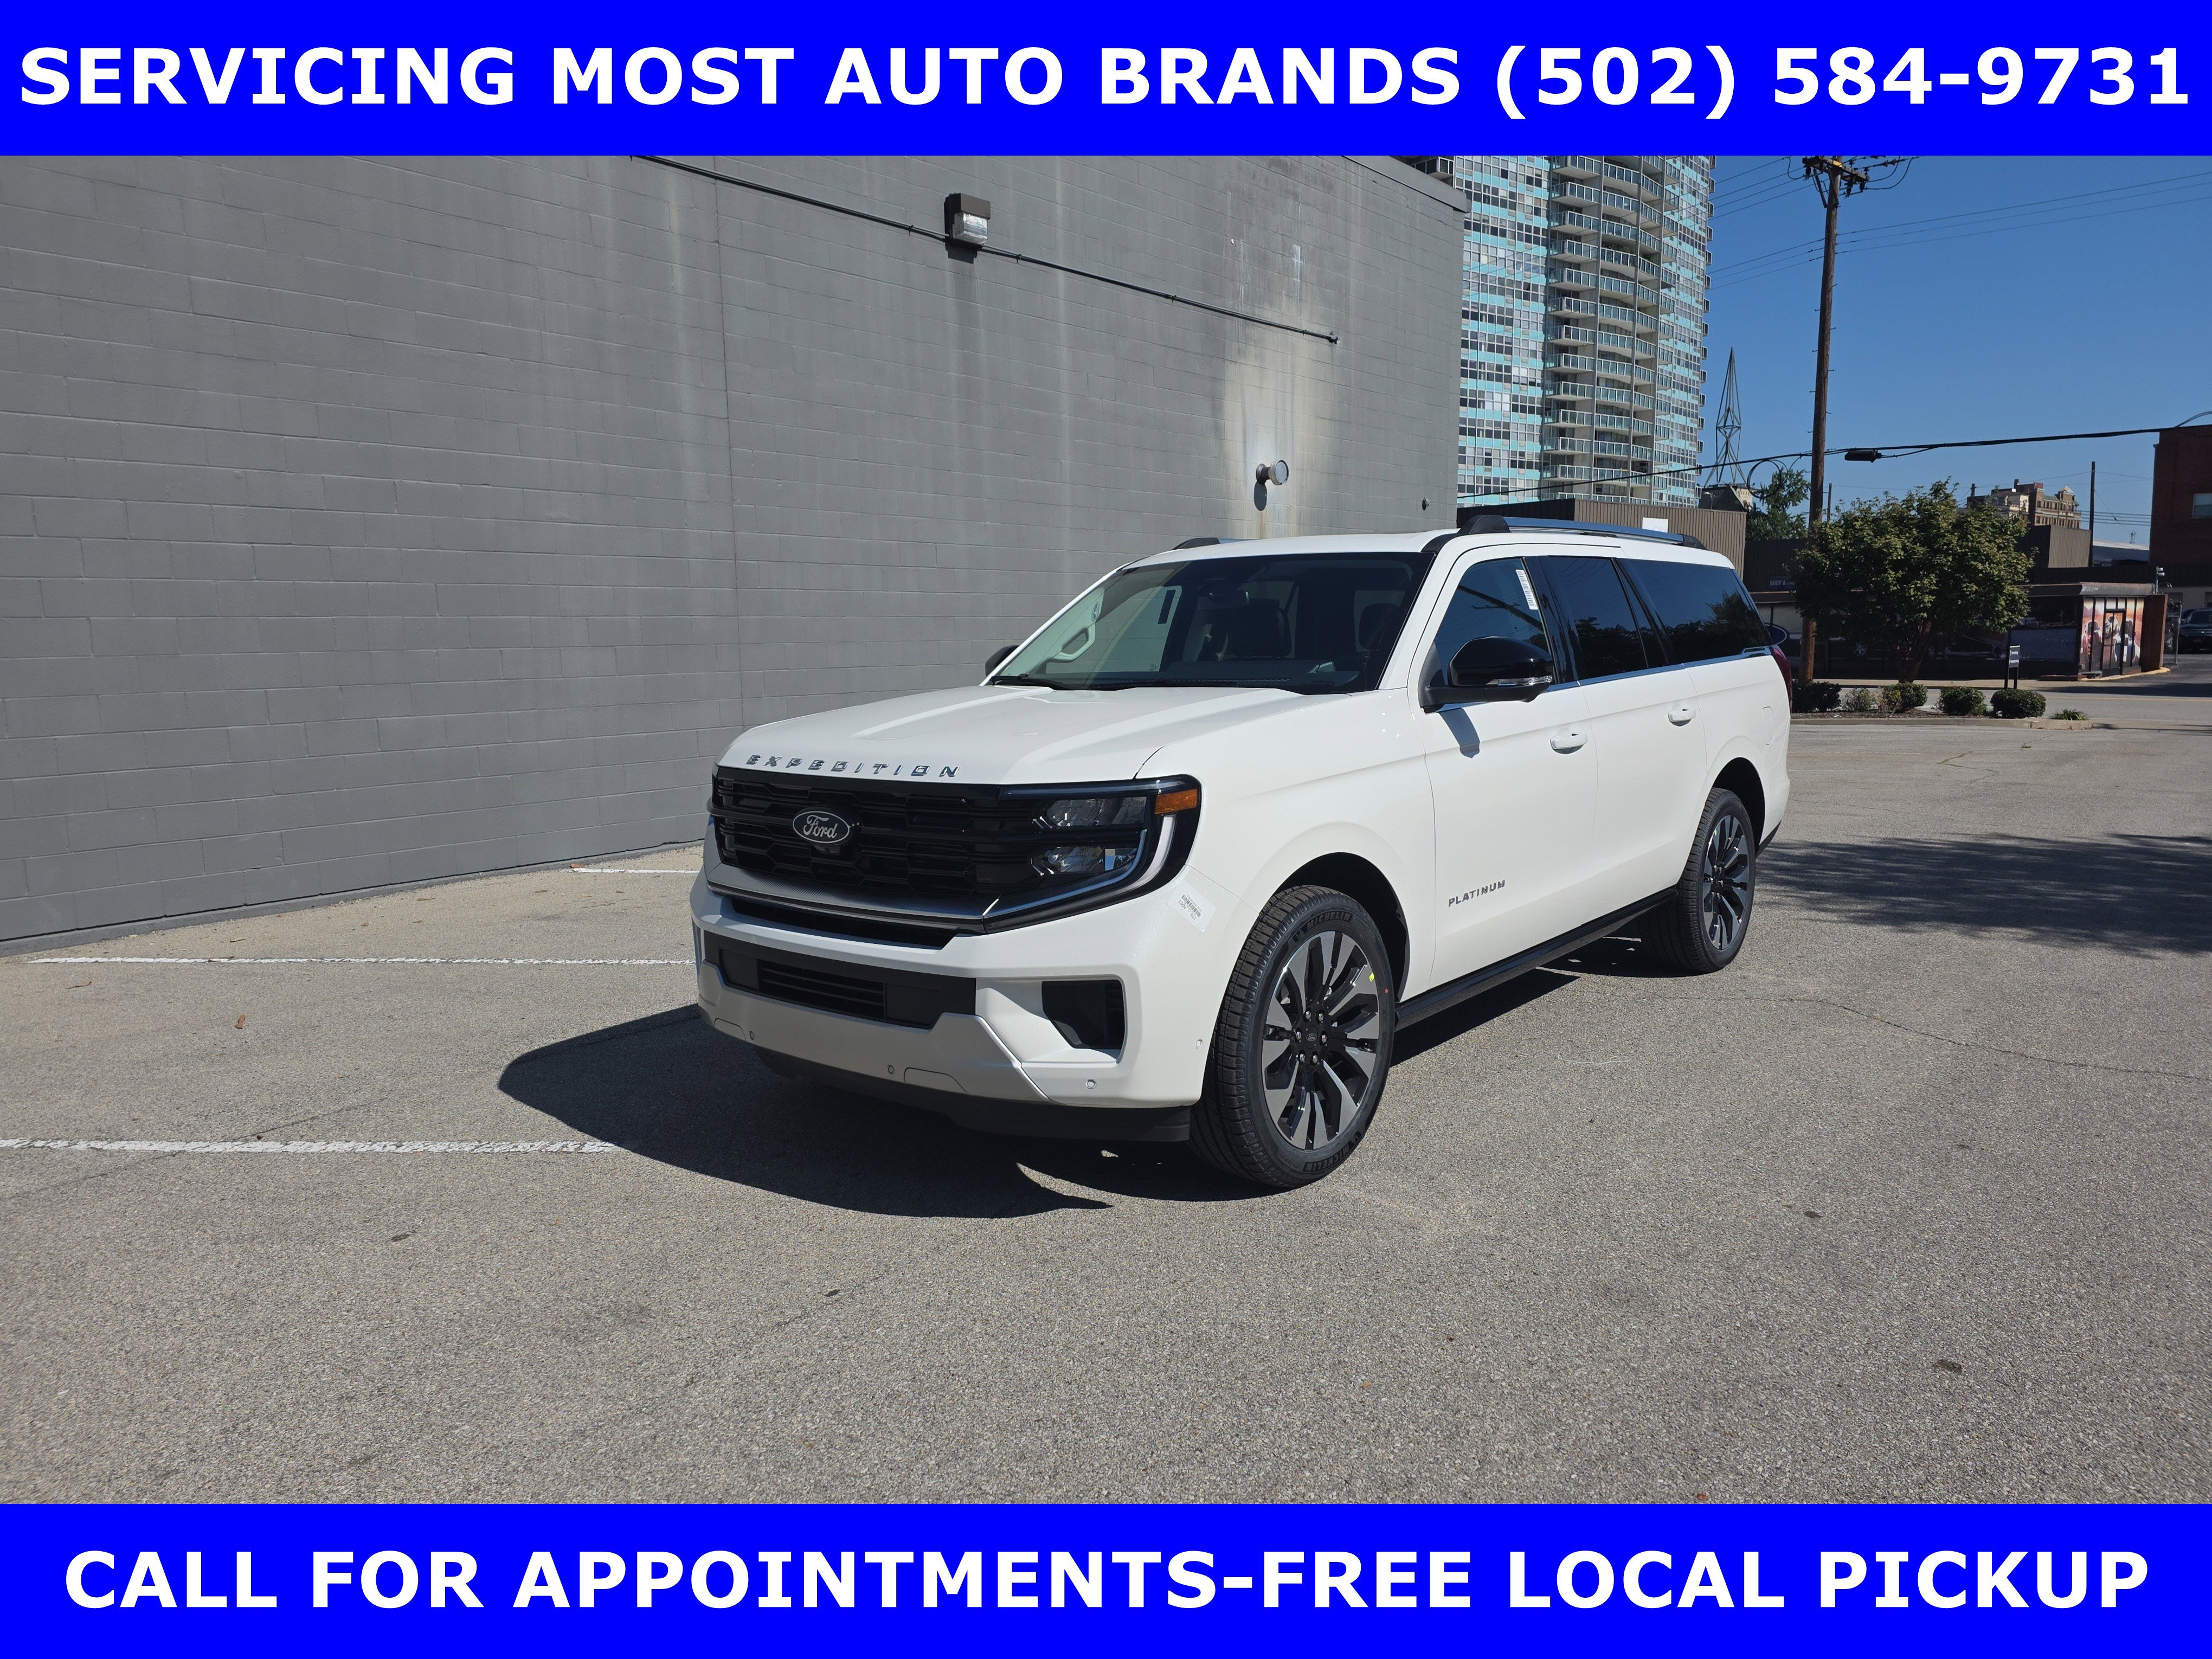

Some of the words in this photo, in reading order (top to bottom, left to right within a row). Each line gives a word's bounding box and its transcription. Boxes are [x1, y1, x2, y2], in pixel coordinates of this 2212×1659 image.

[746, 754, 961, 777] EXPEDITION
[803, 814, 838, 839] Ford
[1448, 879, 1506, 908] PLATINUM
[1307, 911, 1351, 929] MICHELIN
[1306, 1144, 1349, 1171] MICHELIN
